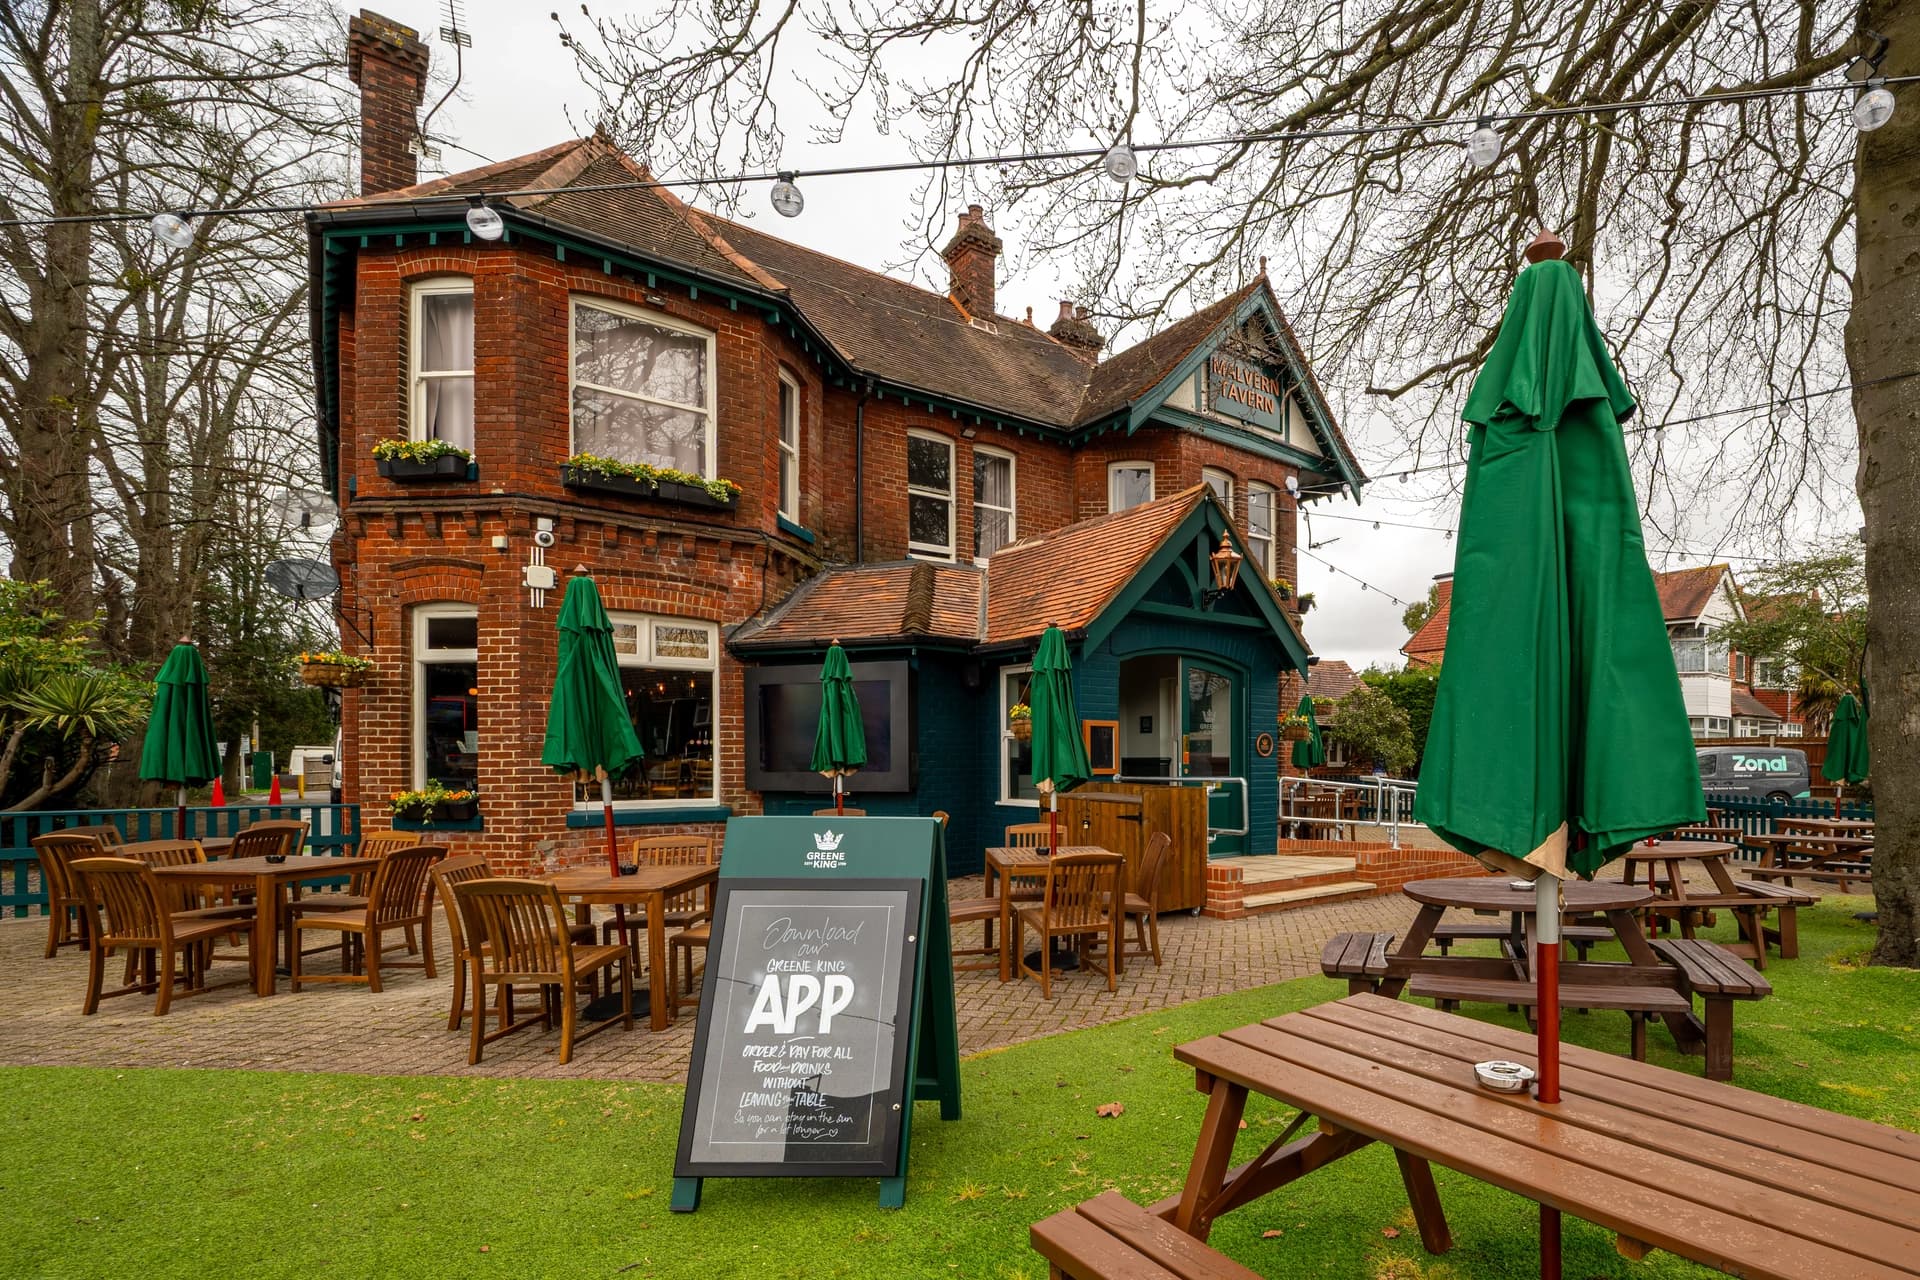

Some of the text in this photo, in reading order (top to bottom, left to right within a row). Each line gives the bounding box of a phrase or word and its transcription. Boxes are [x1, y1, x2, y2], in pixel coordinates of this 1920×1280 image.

[1212, 357, 1280, 397] MALVERN
[1221, 380, 1274, 414] TAVERN
[1732, 755, 1788, 772] Zonal
[806, 852, 846, 861] GREENE
[813, 860, 837, 869] KING
[763, 916, 865, 950] Download
[797, 943, 828, 957] our
[767, 958, 846, 973] GREENE KING
[743, 974, 855, 1034] APP
[742, 1045, 777, 1058] ORDER
[789, 1045, 811, 1059] PAY
[812, 1046, 832, 1059] FOR
[833, 1047, 853, 1060] ALL
[790, 1062, 833, 1075] DRINKS
[740, 1092, 781, 1108] LEAVING
[795, 1092, 826, 1108] TABLE
